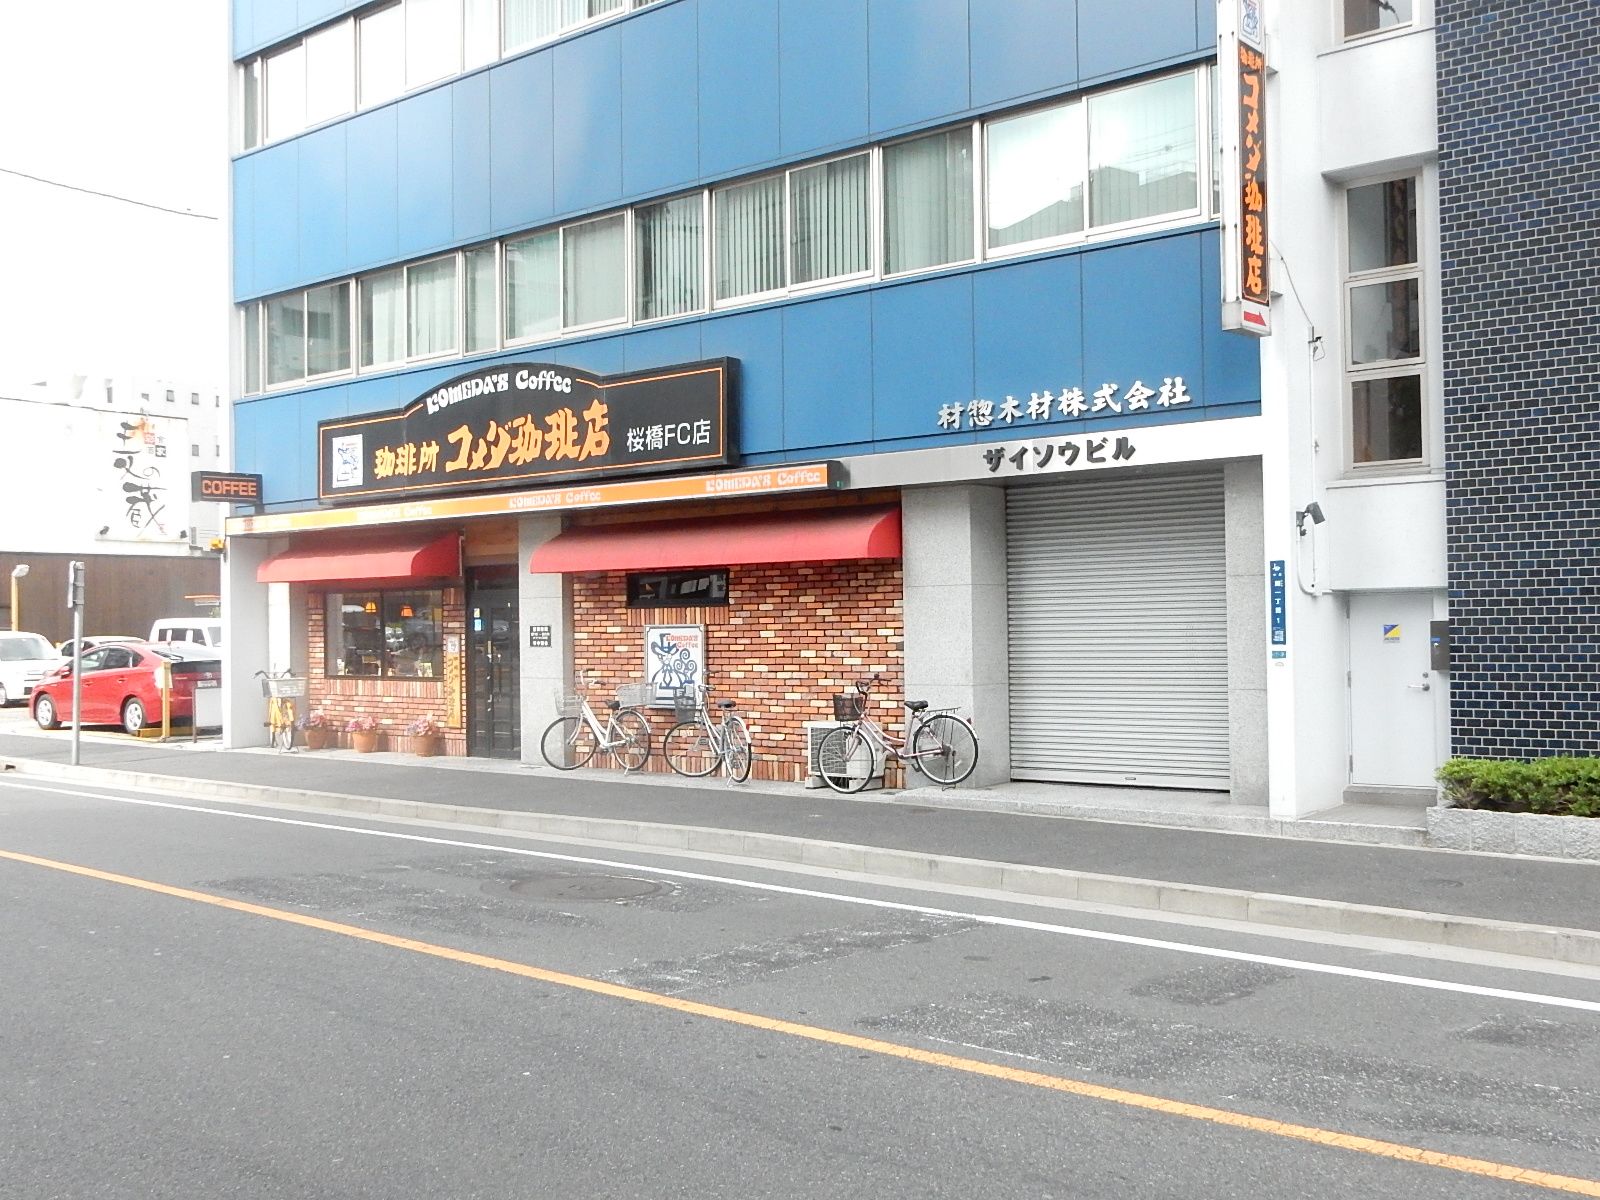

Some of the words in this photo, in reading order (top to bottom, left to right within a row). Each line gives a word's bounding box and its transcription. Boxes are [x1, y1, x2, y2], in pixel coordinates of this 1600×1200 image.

[1243, 73, 1262, 294] コメダ珈琲店
[426, 373, 509, 415] KOMEDA'S
[516, 370, 572, 394] Coffee
[937, 376, 1191, 429] 材惣木材株式会社
[374, 440, 440, 479] 珈琲所
[446, 399, 610, 472] コメダ珈琲店
[626, 419, 711, 453] 桜橋FC店
[983, 436, 1136, 472] ザイソウビル
[202, 479, 257, 496] COFFEE
[777, 470, 821, 485] Coffee
